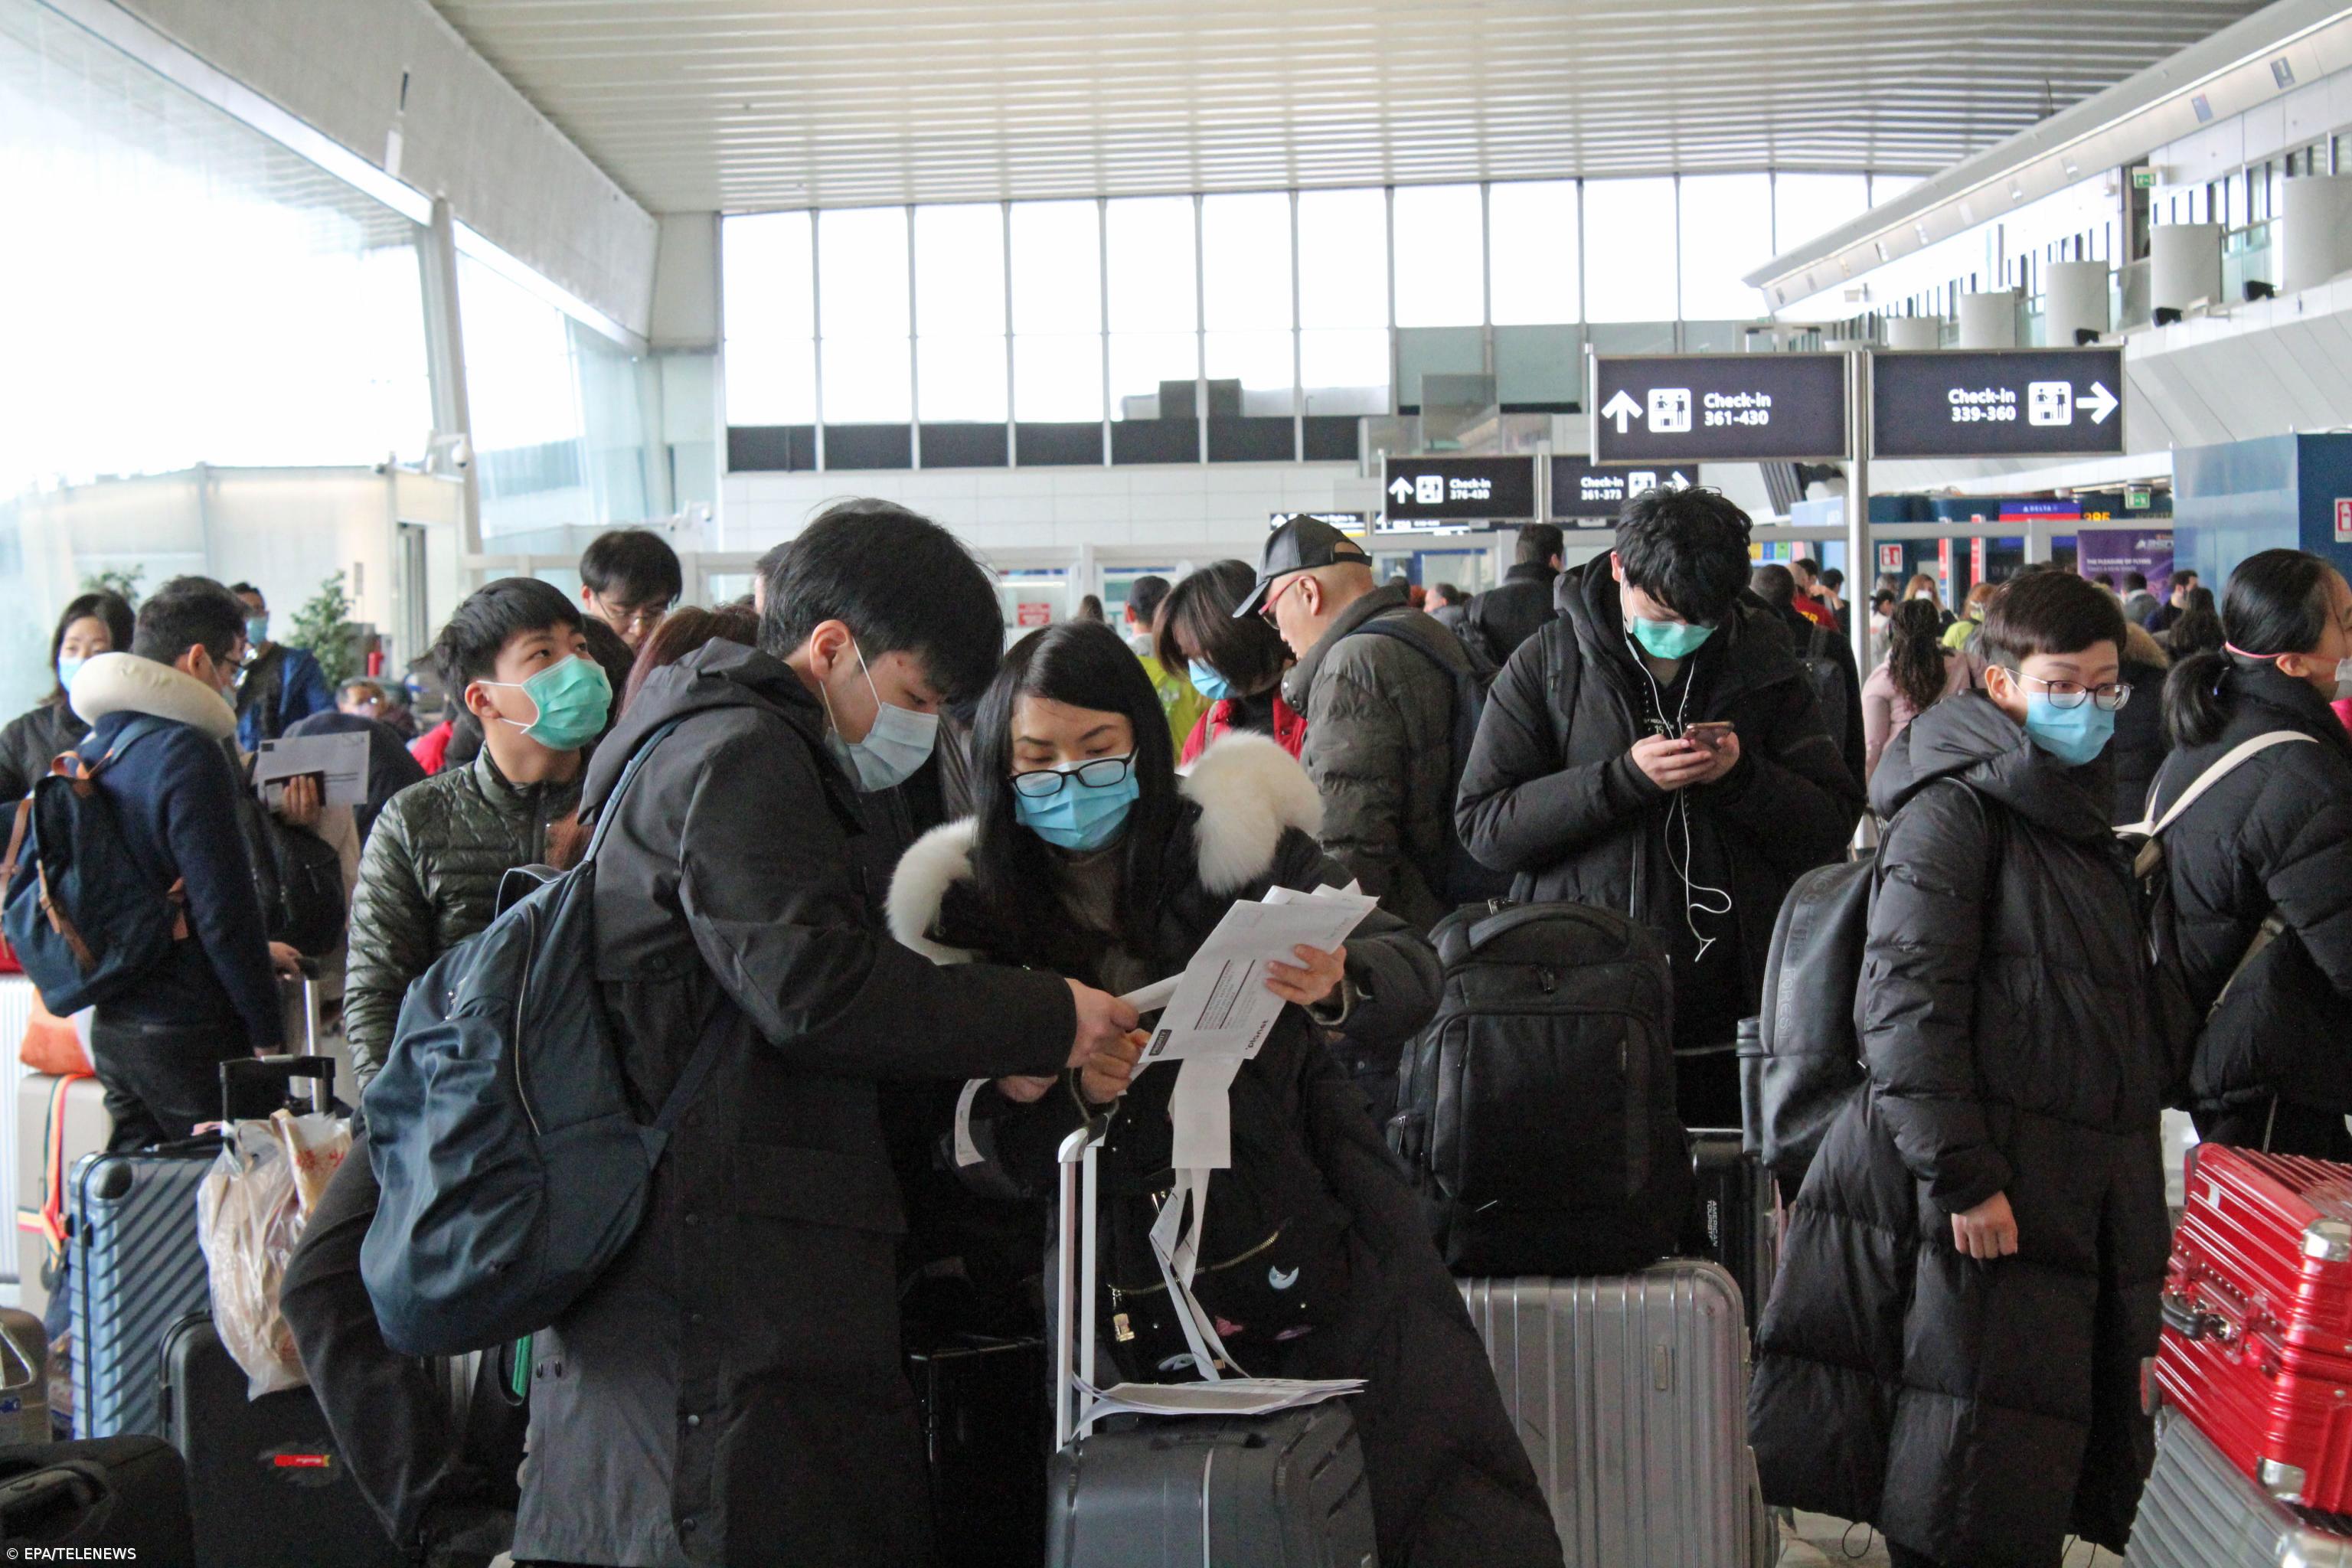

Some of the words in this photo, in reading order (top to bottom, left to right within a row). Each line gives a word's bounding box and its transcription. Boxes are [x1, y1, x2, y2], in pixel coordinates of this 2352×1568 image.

[1704, 392, 1772, 409] Check-in
[1949, 387, 2016, 404] Check-in
[1704, 410, 1769, 426] 361-430
[1952, 406, 2017, 422] 339-360
[1449, 478, 1491, 489] Check-in
[1579, 476, 1624, 488] Check-in
[1449, 489, 1490, 500] 376-430
[1580, 489, 1622, 500] 361-373
